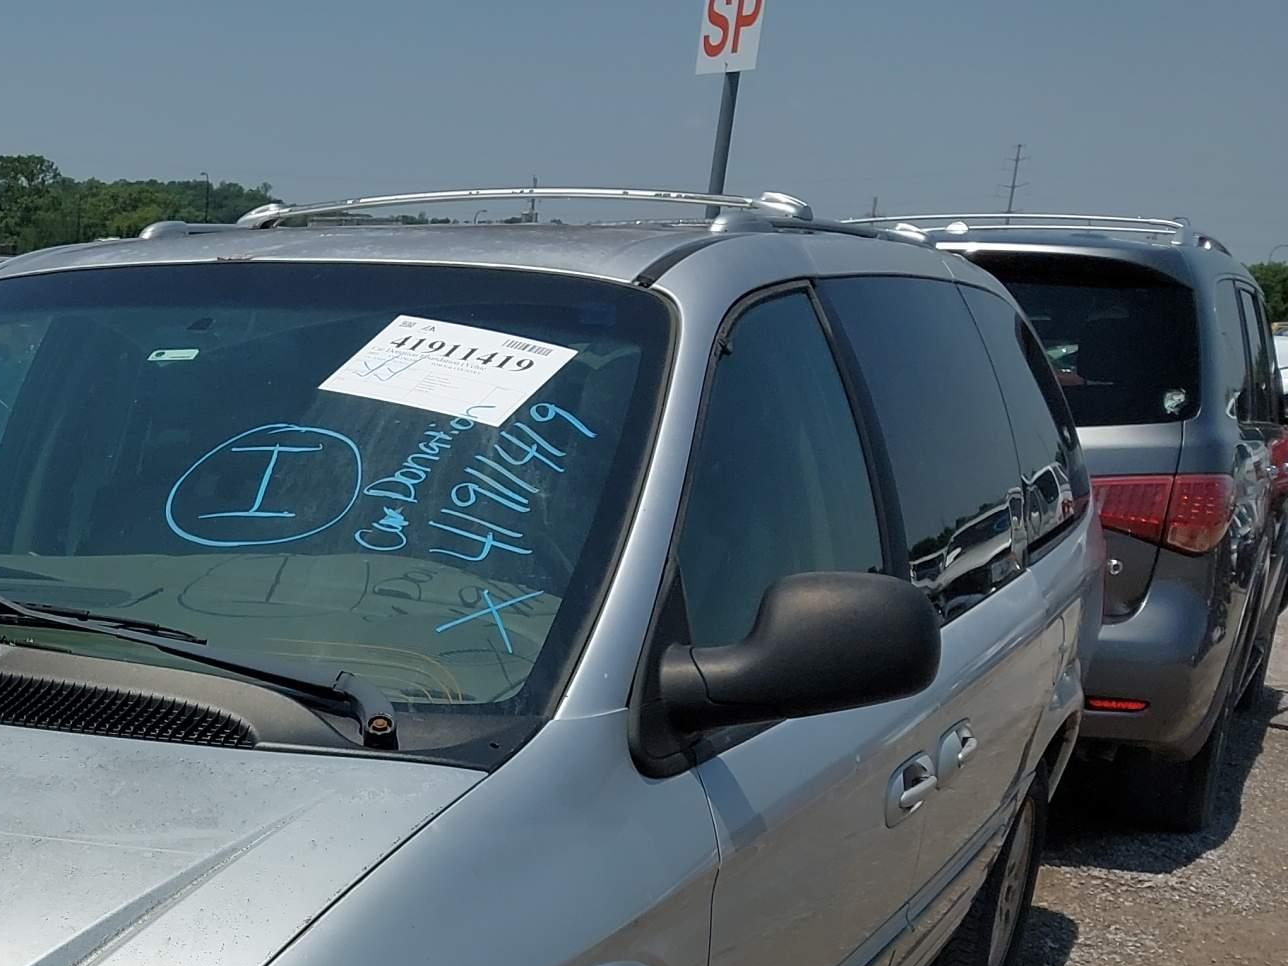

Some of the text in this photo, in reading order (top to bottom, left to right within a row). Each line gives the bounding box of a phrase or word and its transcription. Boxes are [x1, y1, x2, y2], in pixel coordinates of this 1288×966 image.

[704, 0, 763, 57] SP
[390, 335, 535, 372] 41911419
[429, 403, 597, 561] 41911419
